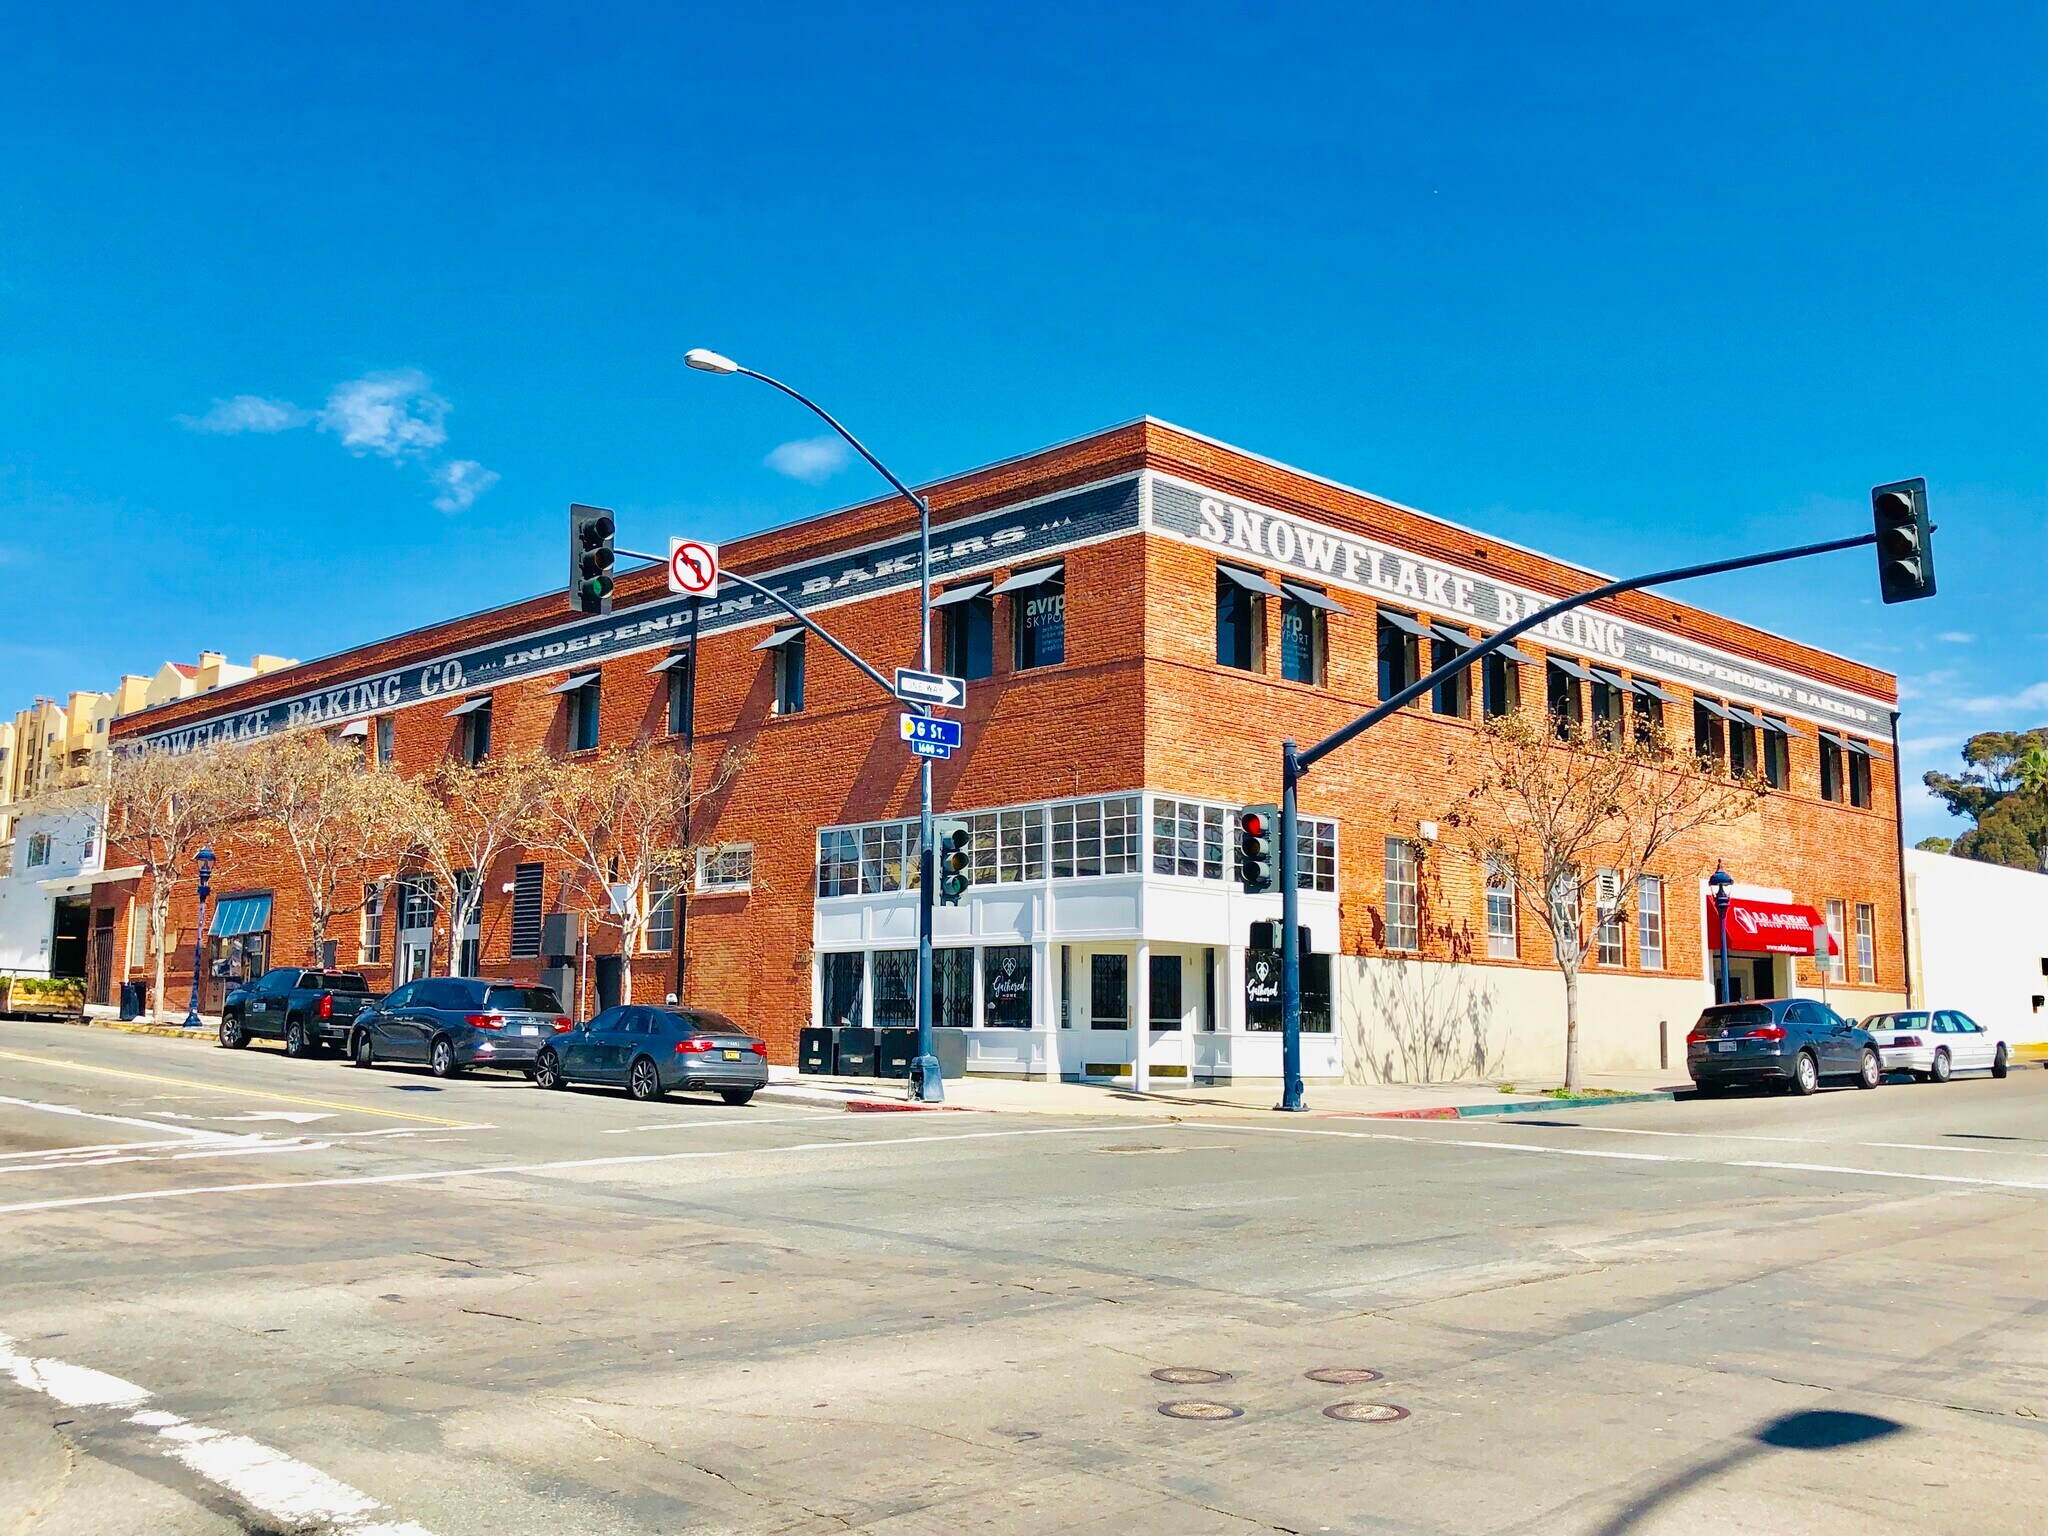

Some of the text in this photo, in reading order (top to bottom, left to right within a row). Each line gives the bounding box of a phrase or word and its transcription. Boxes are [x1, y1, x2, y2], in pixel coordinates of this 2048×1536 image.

[1200, 498, 1868, 722] SNOWFLAKE BAKING INDEPENDENT BAKERS
[287, 674, 402, 729] BAKING
[420, 659, 469, 697] CO.
[504, 585, 788, 667] INDEPENDENT
[801, 525, 1027, 596] BAKERS
[917, 721, 926, 737] G
[992, 975, 1026, 998] Gathered
[1246, 978, 1278, 1001] Gathered
